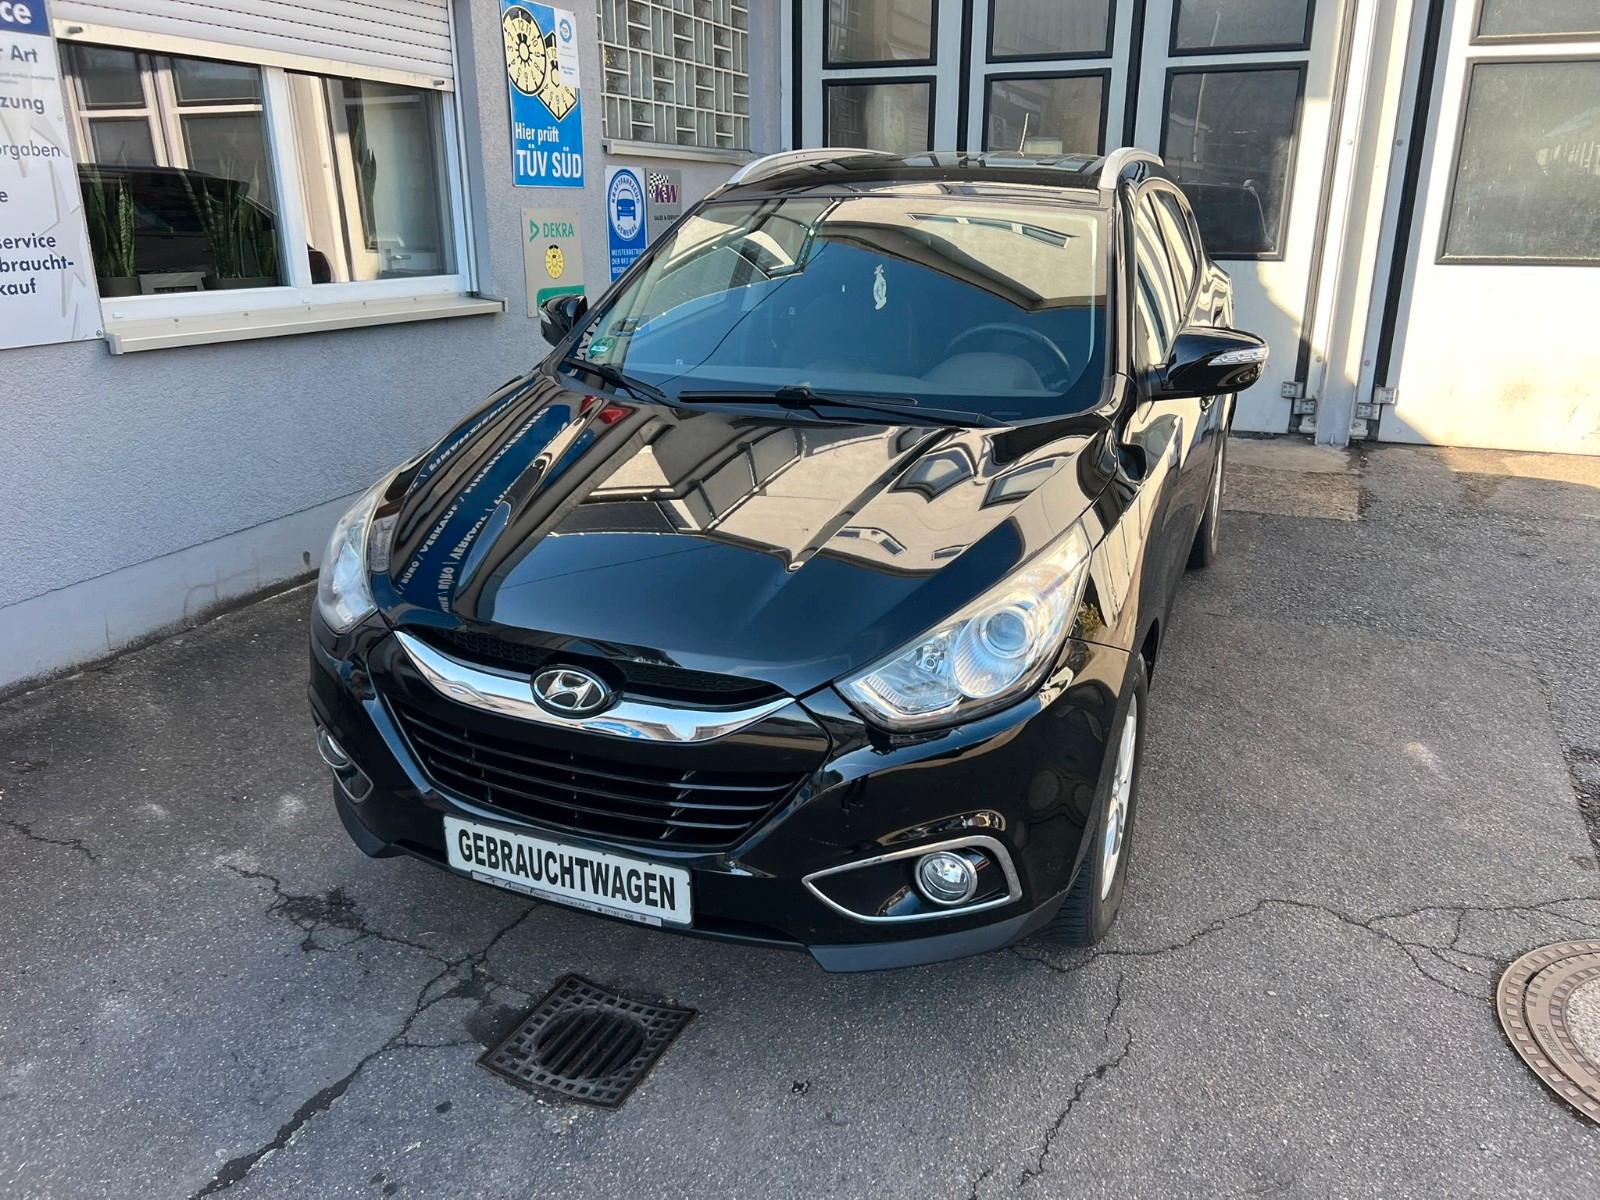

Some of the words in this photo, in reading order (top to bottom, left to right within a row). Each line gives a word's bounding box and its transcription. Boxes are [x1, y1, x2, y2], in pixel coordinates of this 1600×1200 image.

[0, 1, 32, 24] ce
[11, 45, 38, 63] Art
[0, 96, 45, 114] zung
[515, 121, 536, 141] Hier
[537, 125, 560, 146] prüft
[0, 139, 61, 160] rgaben
[516, 145, 548, 177] TÜV
[552, 147, 582, 179] SÜD
[543, 222, 575, 239] DEKRA
[0, 254, 74, 273] braucht-
[458, 829, 676, 911] GEBRAUCHTWAGEN
